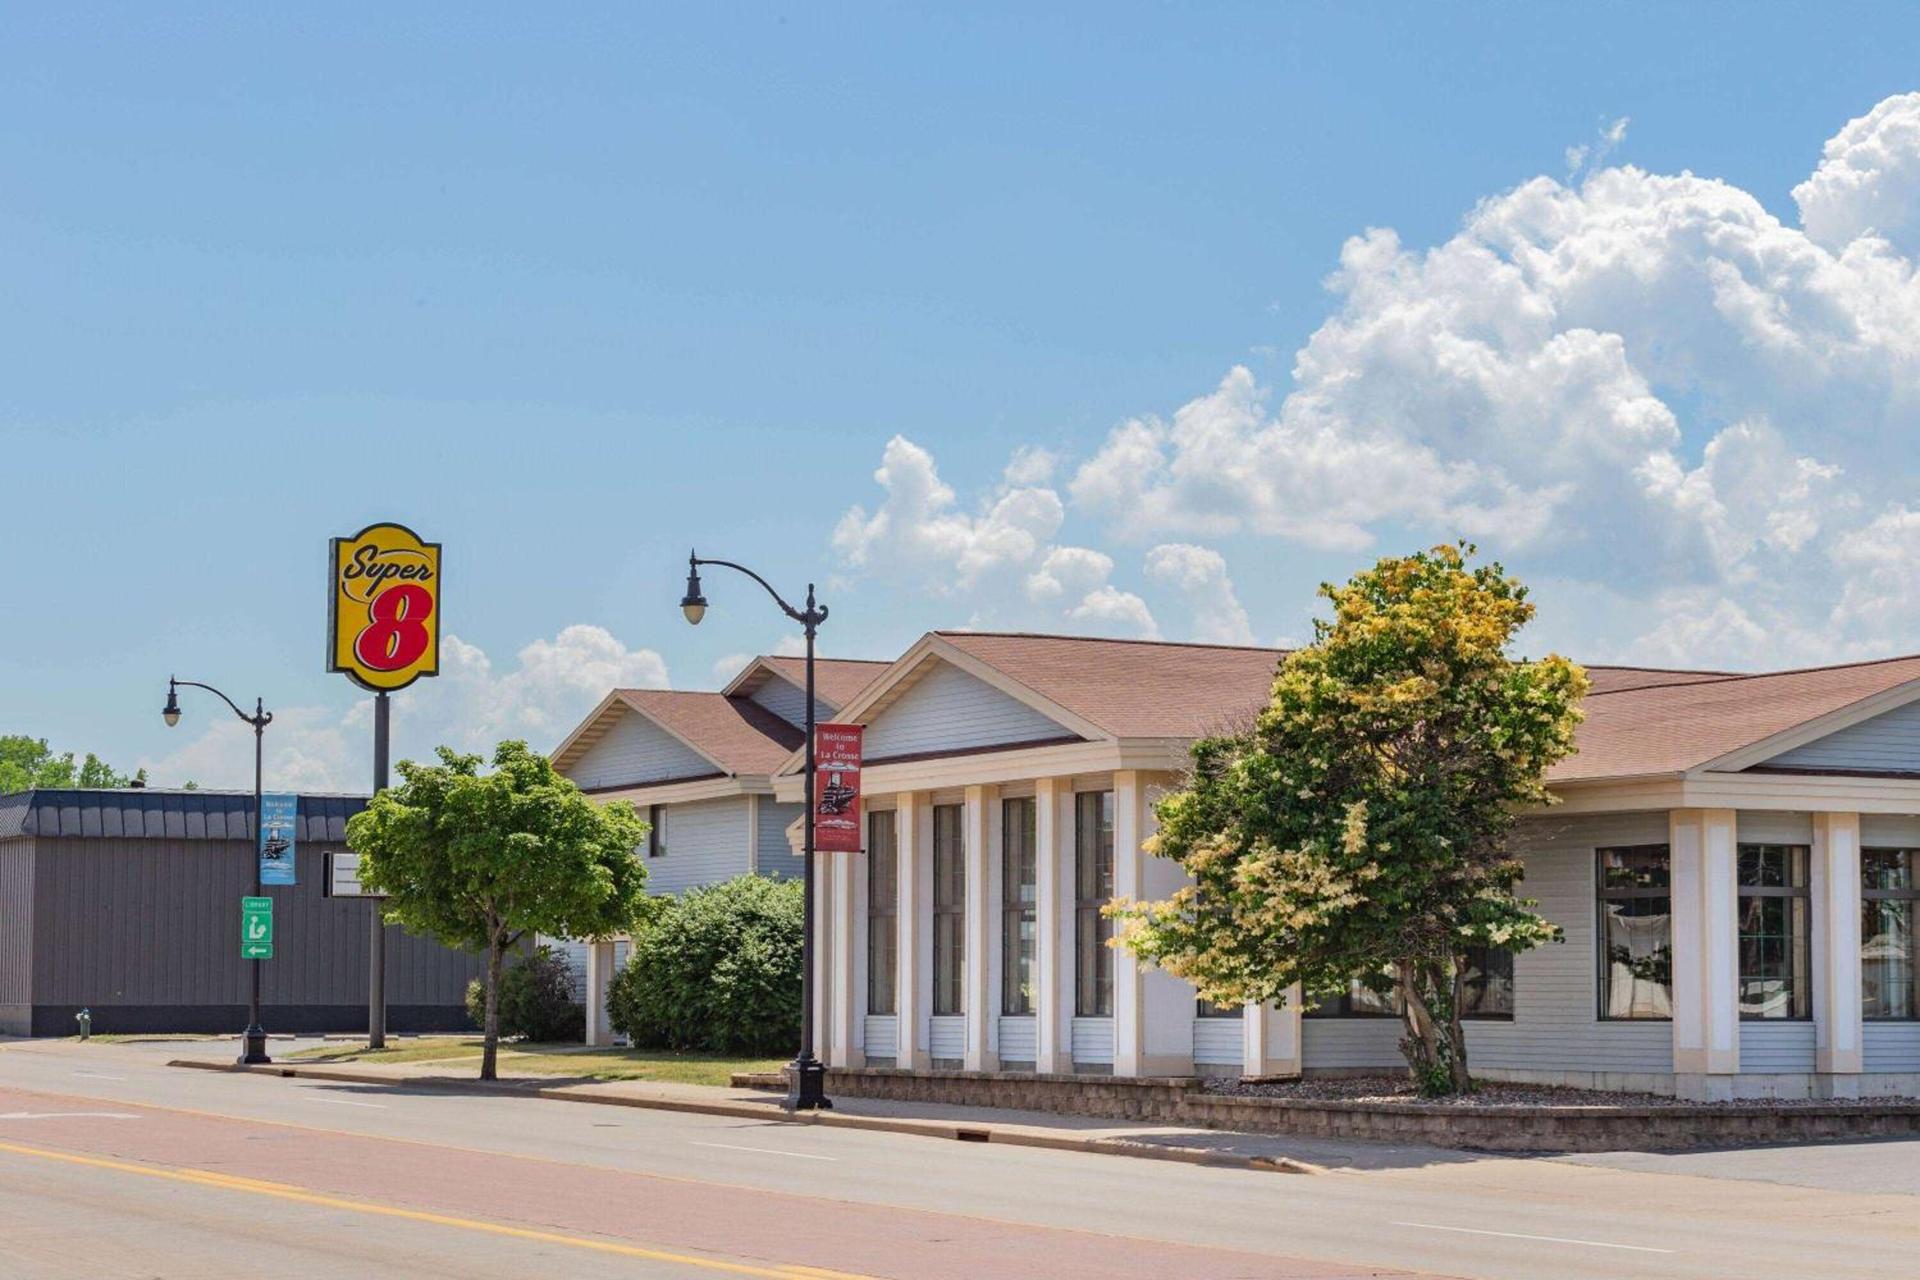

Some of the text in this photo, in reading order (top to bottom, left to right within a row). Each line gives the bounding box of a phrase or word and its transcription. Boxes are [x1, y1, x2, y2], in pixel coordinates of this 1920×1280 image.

[343, 544, 434, 598] Super
[353, 583, 434, 672] 8
[822, 733, 857, 742] Welcome
[820, 751, 859, 760] La Crosse
